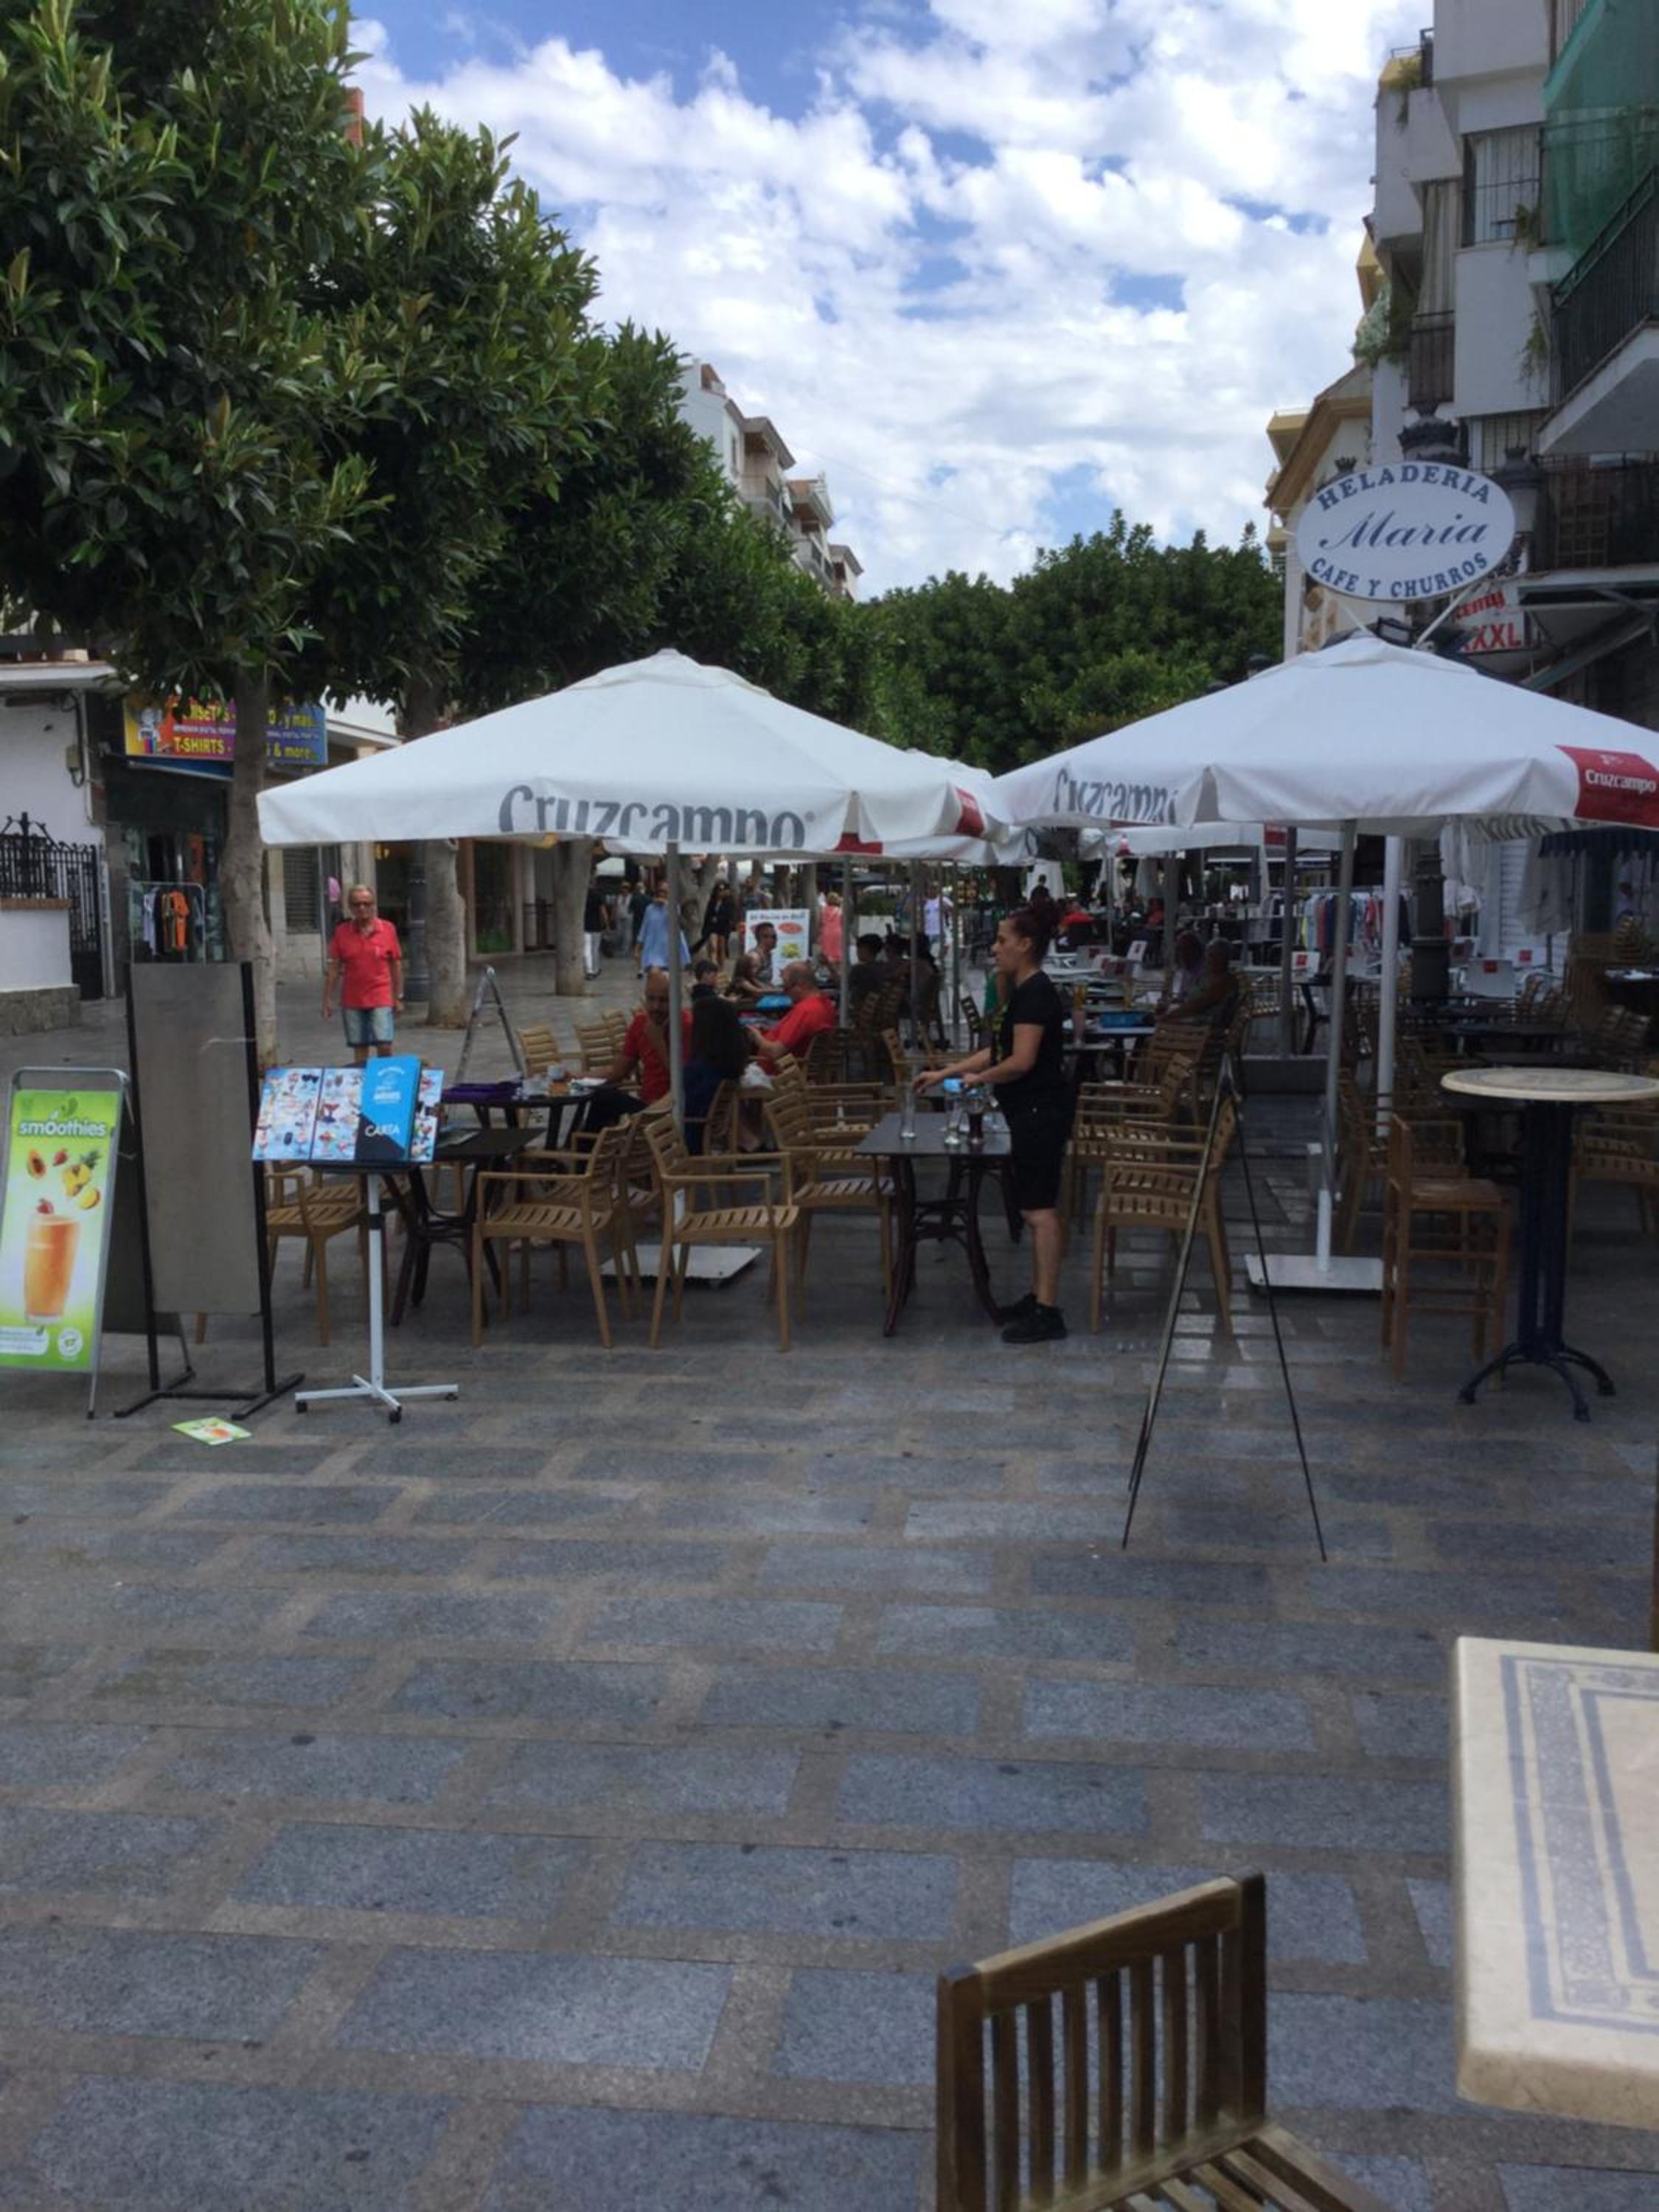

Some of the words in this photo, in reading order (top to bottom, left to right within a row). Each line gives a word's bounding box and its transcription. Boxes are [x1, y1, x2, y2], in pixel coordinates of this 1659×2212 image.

[1317, 465, 1490, 511] HELADERIA
[1318, 509, 1490, 550] Maria
[1311, 557, 1359, 592] CAFE
[1368, 579, 1381, 597] Y
[1391, 552, 1488, 598] CHURROS
[1585, 768, 1657, 796] Cruzcampo
